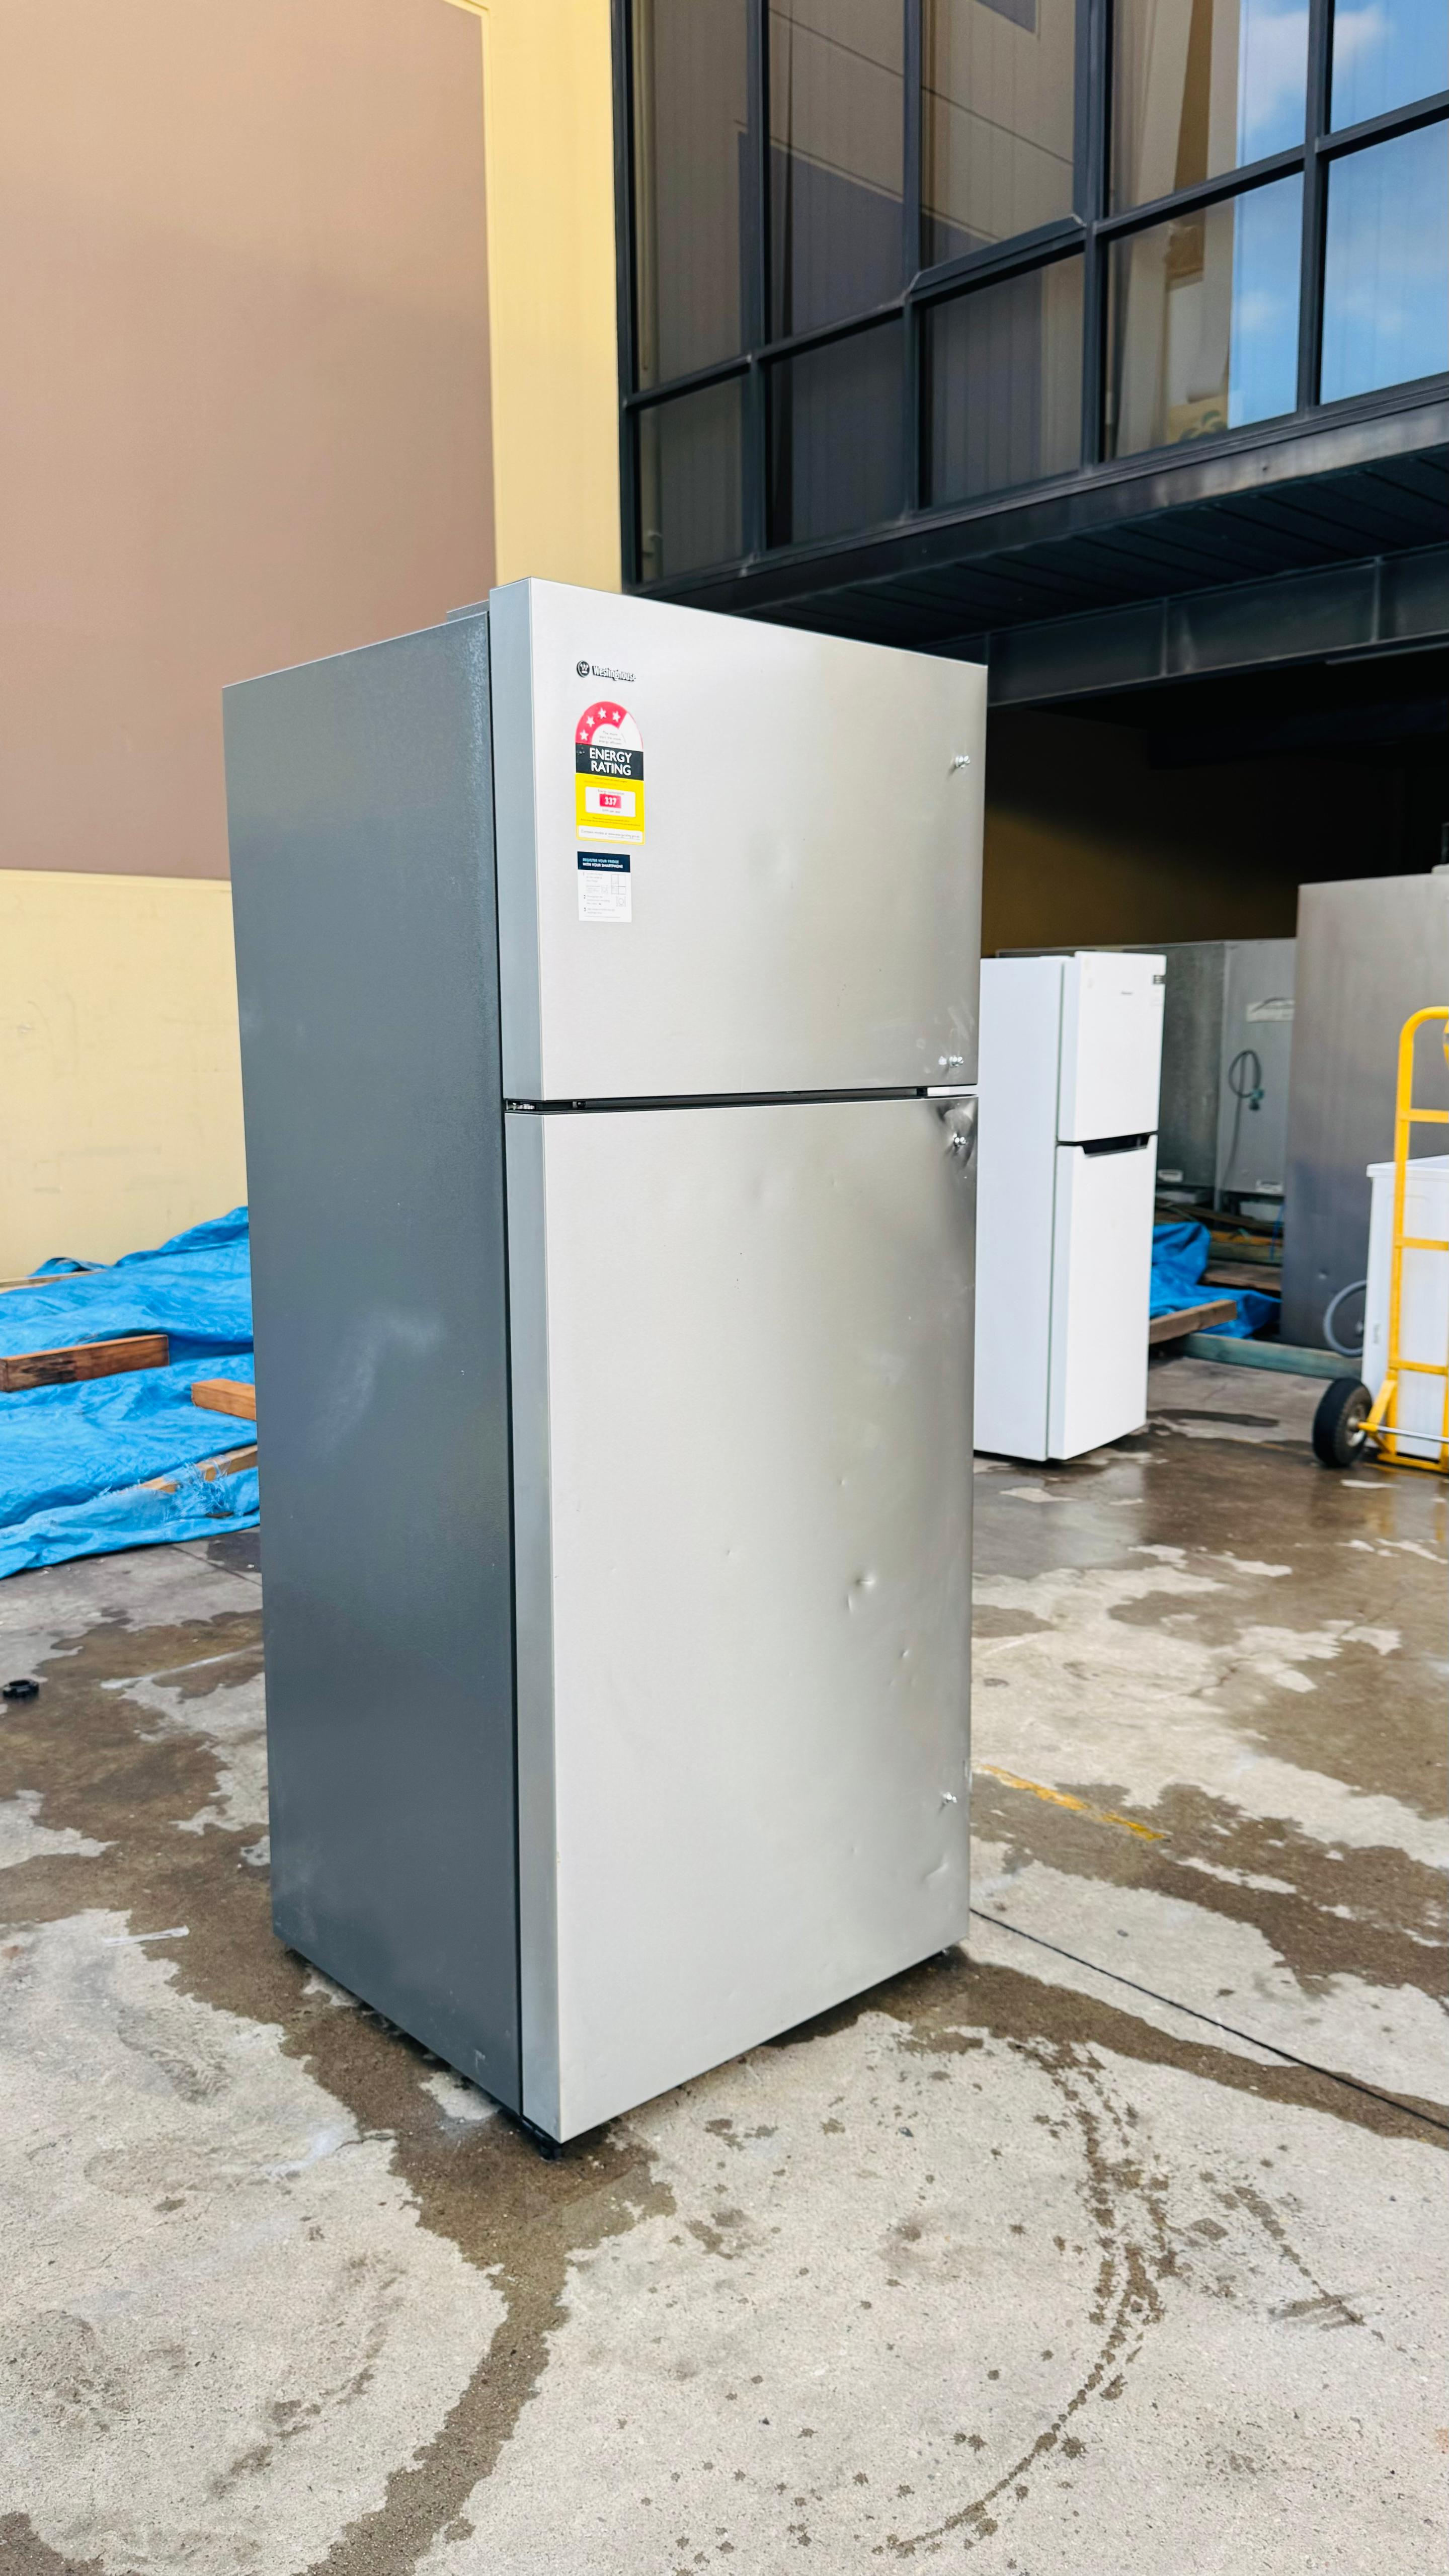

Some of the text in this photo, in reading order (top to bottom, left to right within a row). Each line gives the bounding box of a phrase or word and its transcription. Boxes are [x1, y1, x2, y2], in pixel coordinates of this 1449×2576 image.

[592, 666, 636, 681] Westinghouse
[589, 747, 632, 764] ENERGY
[591, 762, 631, 776] RATING
[604, 796, 617, 806] 337
